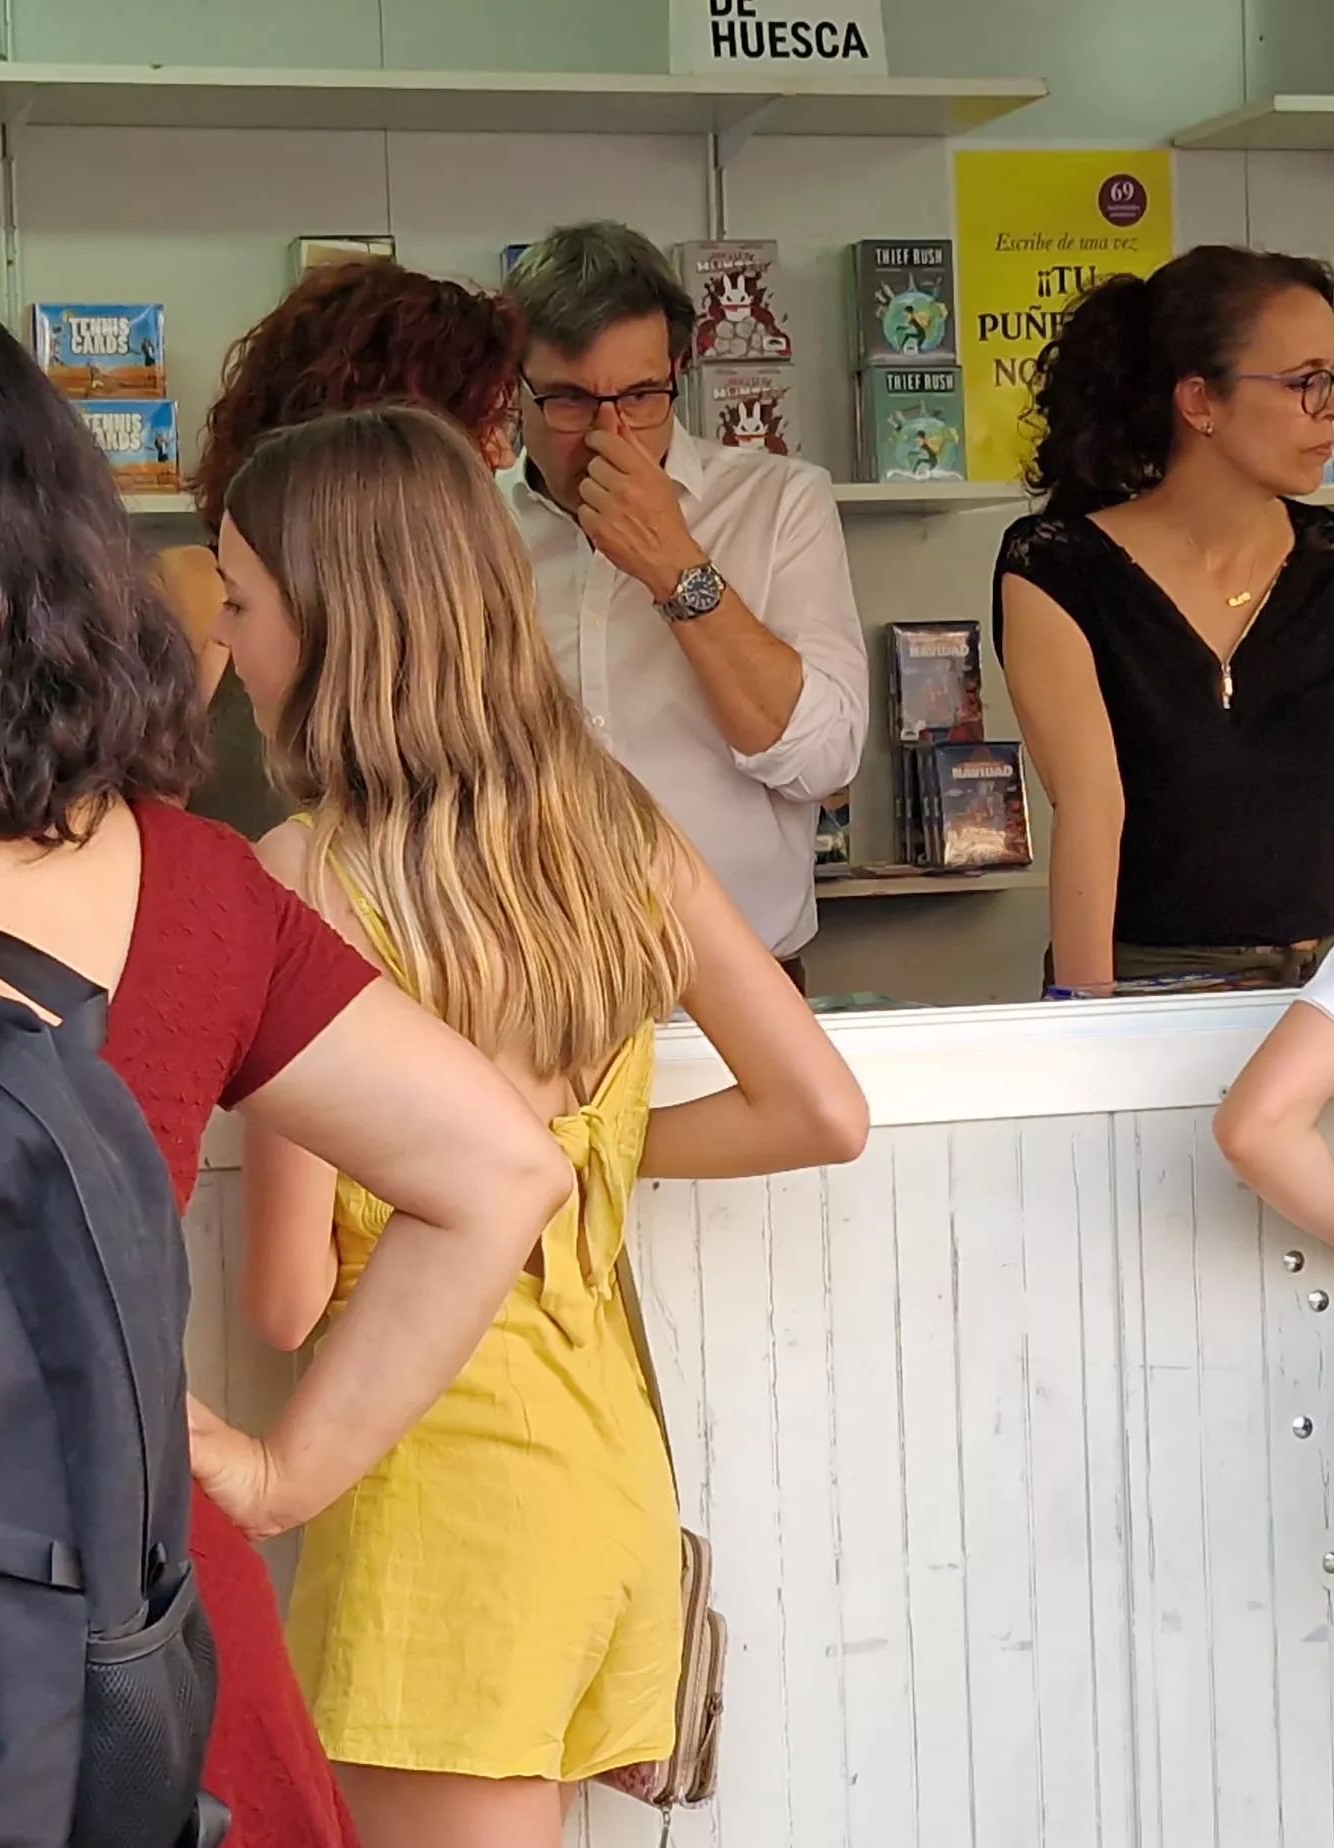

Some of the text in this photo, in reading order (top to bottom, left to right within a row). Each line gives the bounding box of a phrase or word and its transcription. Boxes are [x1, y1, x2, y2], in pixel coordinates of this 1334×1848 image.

[712, 21, 869, 58] HUESCA
[1110, 181, 1135, 202] 69
[995, 232, 1140, 252] Escribe de una vez
[68, 317, 131, 337] TENNIS
[71, 334, 130, 354] CARDS
[94, 431, 142, 451] ARDS
